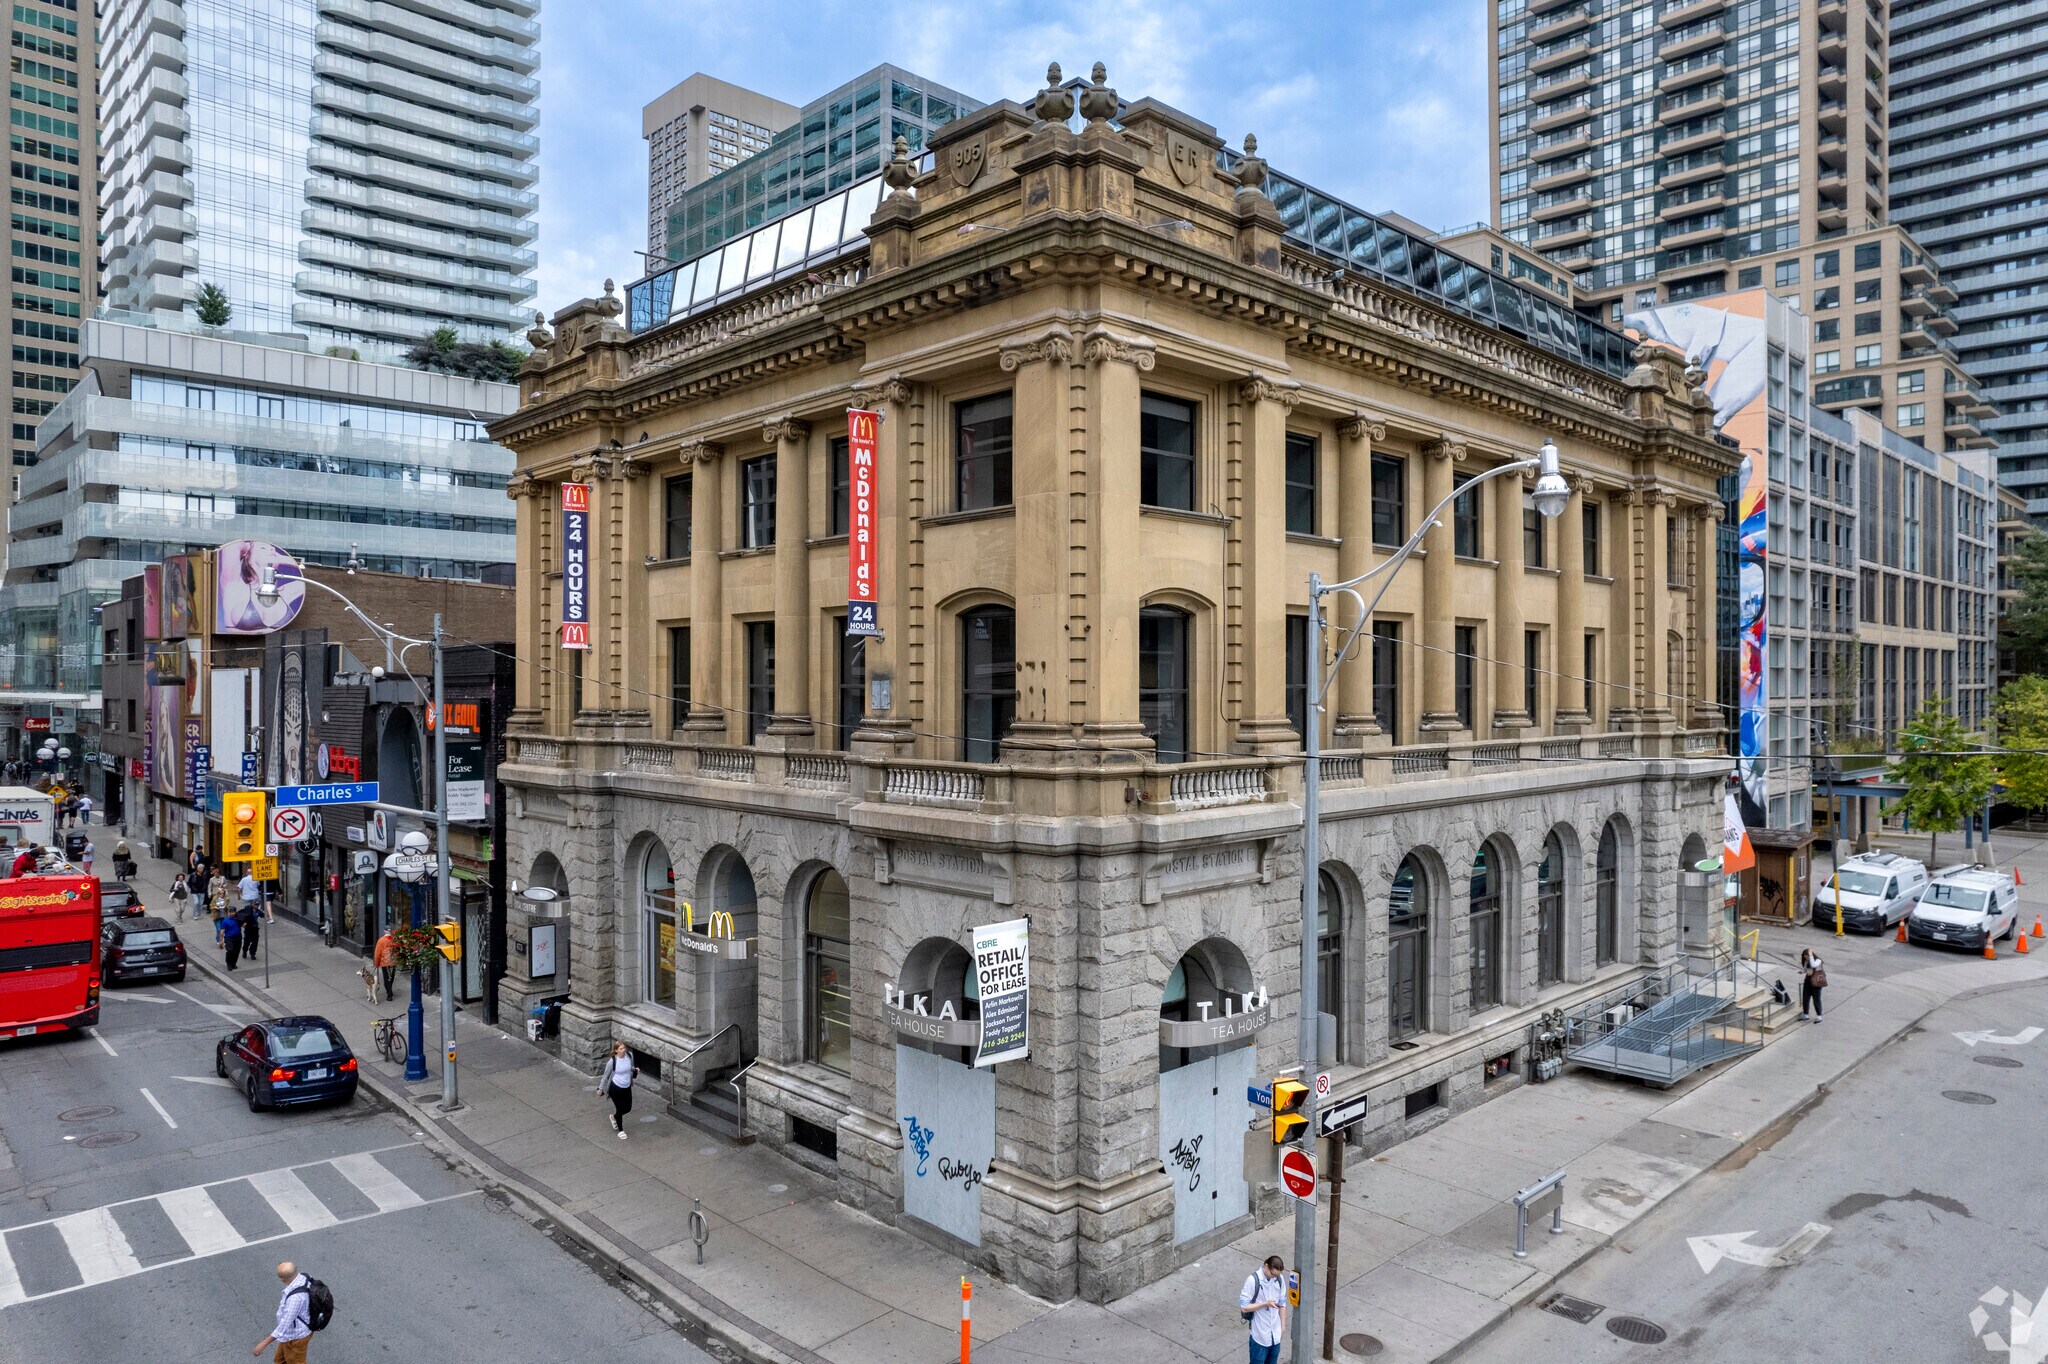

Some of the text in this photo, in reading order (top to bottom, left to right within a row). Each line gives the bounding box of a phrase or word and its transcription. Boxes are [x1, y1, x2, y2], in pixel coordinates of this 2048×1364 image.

[855, 448, 872, 596] McDonald's
[568, 515, 583, 618] 24 HOURS
[853, 606, 872, 621] 24
[850, 622, 875, 630] HOURS
[448, 756, 463, 764] For
[448, 765, 472, 773] Lease
[297, 786, 352, 800] Charles
[896, 848, 984, 874] POSTAL STATION
[1166, 856, 1199, 874] OSTAL
[1202, 850, 1243, 868] STATION
[0, 894, 69, 909] Sightseeing
[976, 939, 998, 949] CBRE
[978, 945, 1026, 968] RETAIL/
[980, 963, 1024, 984] OFFICE
[981, 976, 1026, 996] FOR LEASE
[884, 983, 958, 1022] TIKA
[985, 1001, 998, 1009] Arlin
[1196, 986, 1268, 1022] TIKA
[887, 1011, 944, 1038] TEA HOUSE
[986, 1018, 1005, 1028] Jackson
[1211, 1012, 1266, 1038] TEA HOUSE
[986, 1028, 1001, 1037] Teddy
[983, 1040, 995, 1048] 416
[996, 1036, 1009, 1045] 362
[1256, 1092, 1271, 1105] Yon
